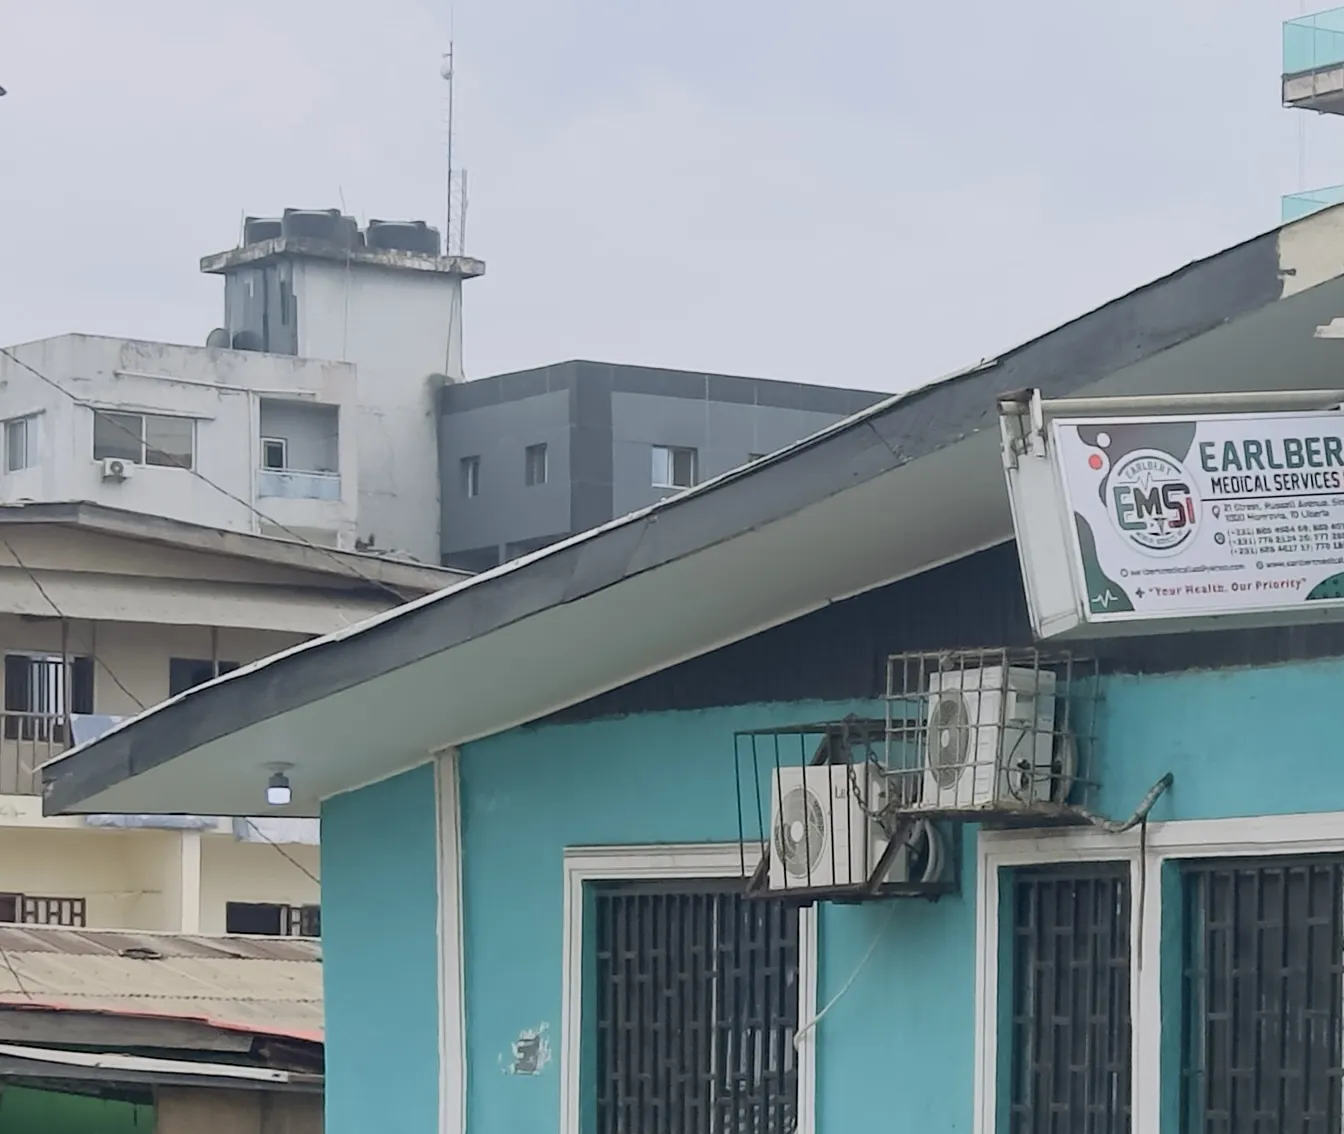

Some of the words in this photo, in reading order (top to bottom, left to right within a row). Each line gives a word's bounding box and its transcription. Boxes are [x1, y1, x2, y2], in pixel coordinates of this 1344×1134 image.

[1211, 475, 1272, 495] MEDICAL
[1273, 471, 1340, 491] SERVICES
[1231, 581, 1252, 592] Our
